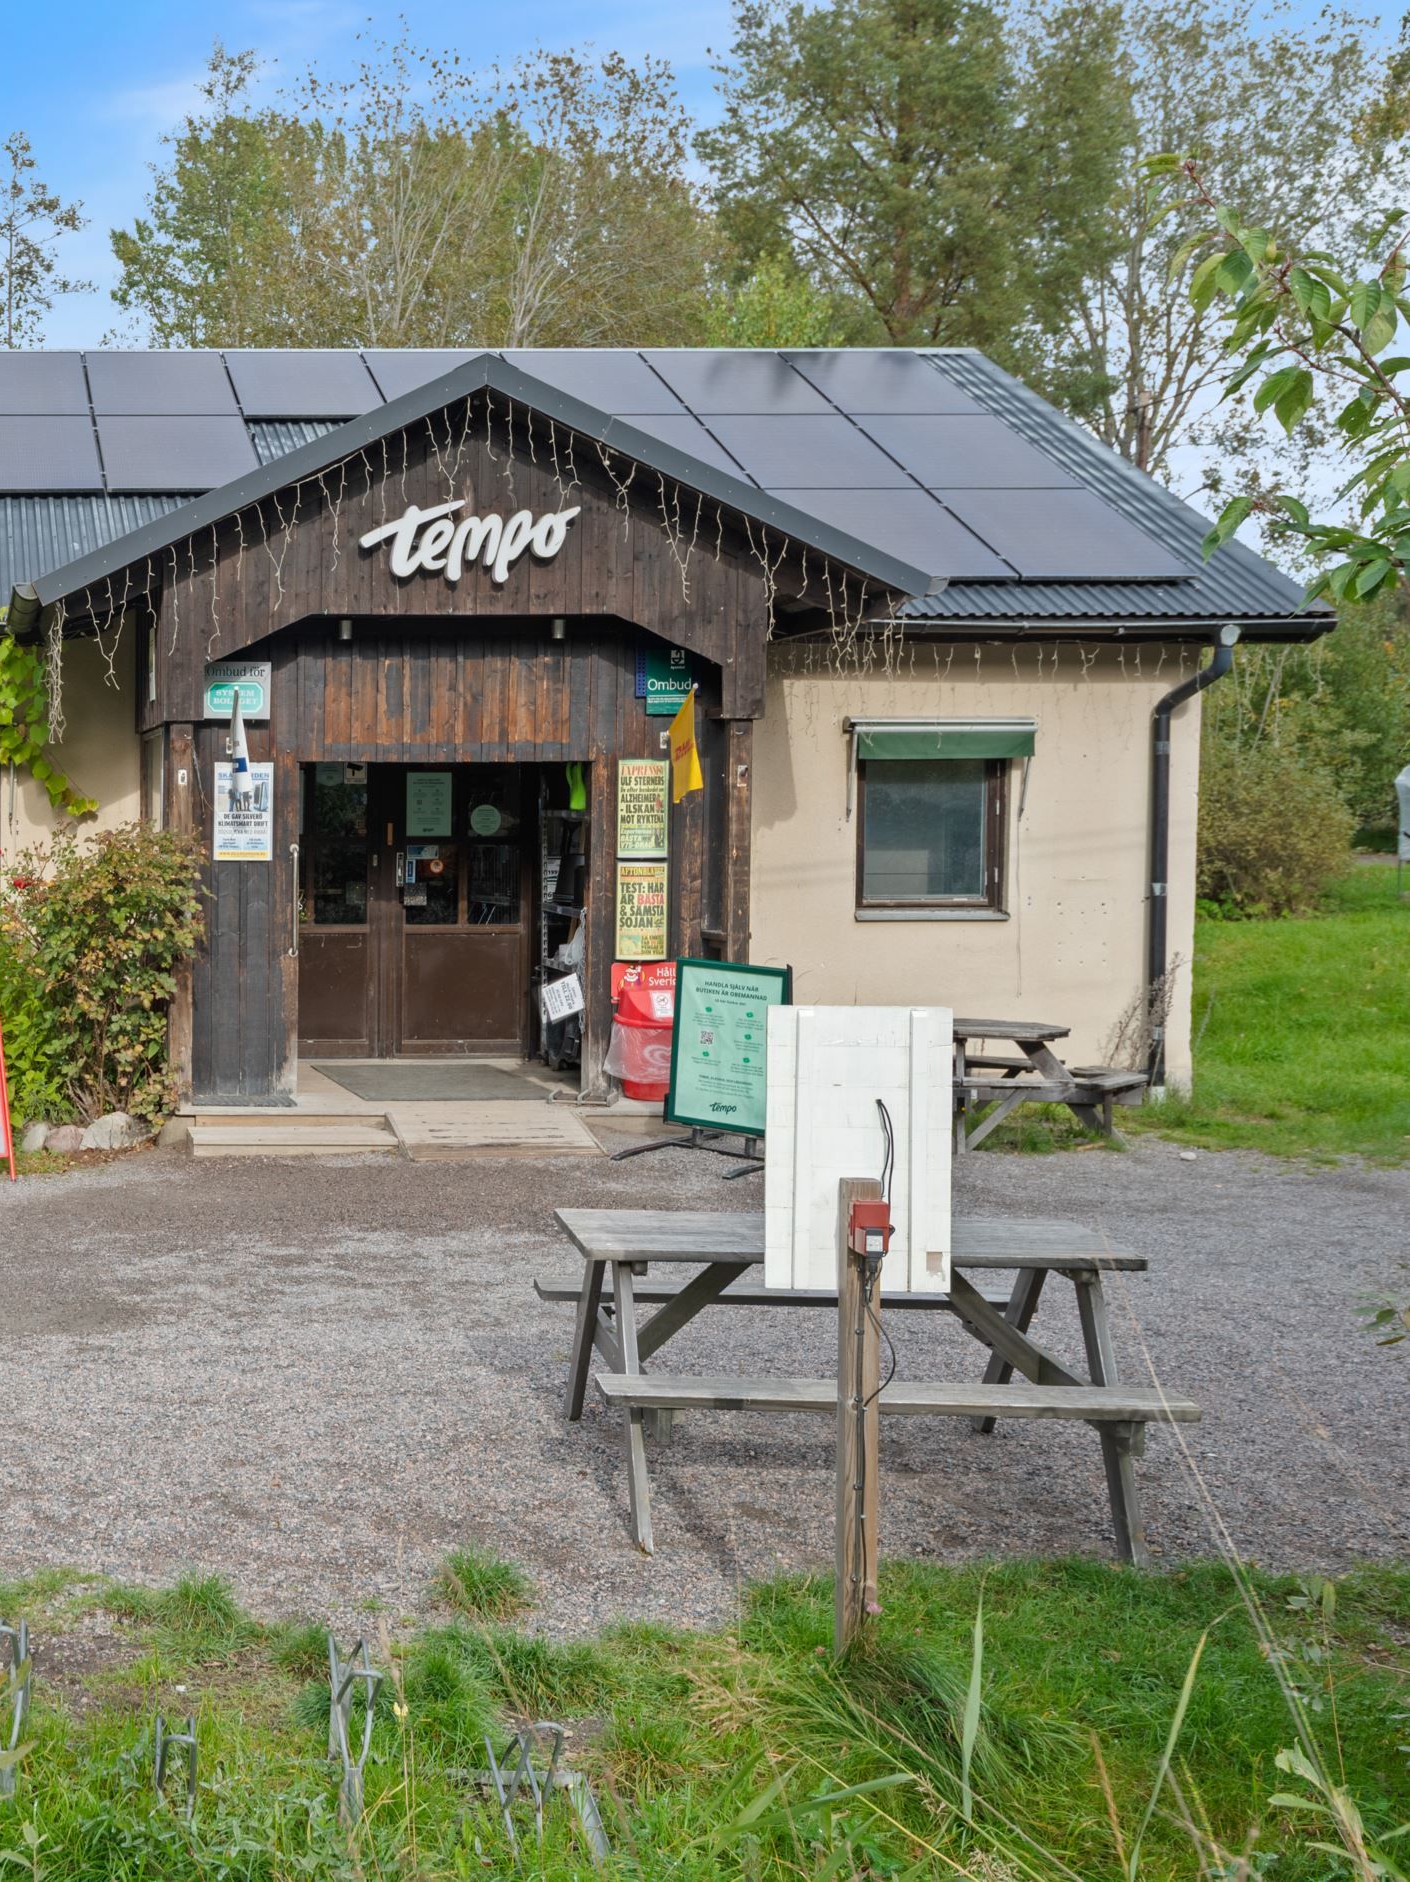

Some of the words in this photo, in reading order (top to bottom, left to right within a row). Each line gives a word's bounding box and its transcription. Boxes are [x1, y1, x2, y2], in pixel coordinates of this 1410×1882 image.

[206, 666, 247, 677] Ombud
[250, 665, 266, 677] för
[647, 677, 692, 691] Ombud
[215, 689, 255, 697] SYSEM
[213, 697, 257, 705] BOLGET
[620, 776, 633, 787] ULF
[634, 776, 665, 787] STERNERS
[620, 815, 635, 825] MOT
[637, 815, 664, 825] RYKTENA
[620, 882, 646, 893] TEST:
[620, 893, 635, 905] ÄR
[637, 893, 665, 905] BÄSTA
[619, 905, 627, 917] &
[619, 916, 654, 929] SOJAN
[656, 966, 677, 977] Håll
[704, 981, 729, 989] HANDLA
[729, 983, 746, 991] SJÄLV
[696, 987, 720, 995] BUTIKEN
[730, 991, 768, 1001] OBEMANNAD
[709, 1101, 737, 1115] tempo
